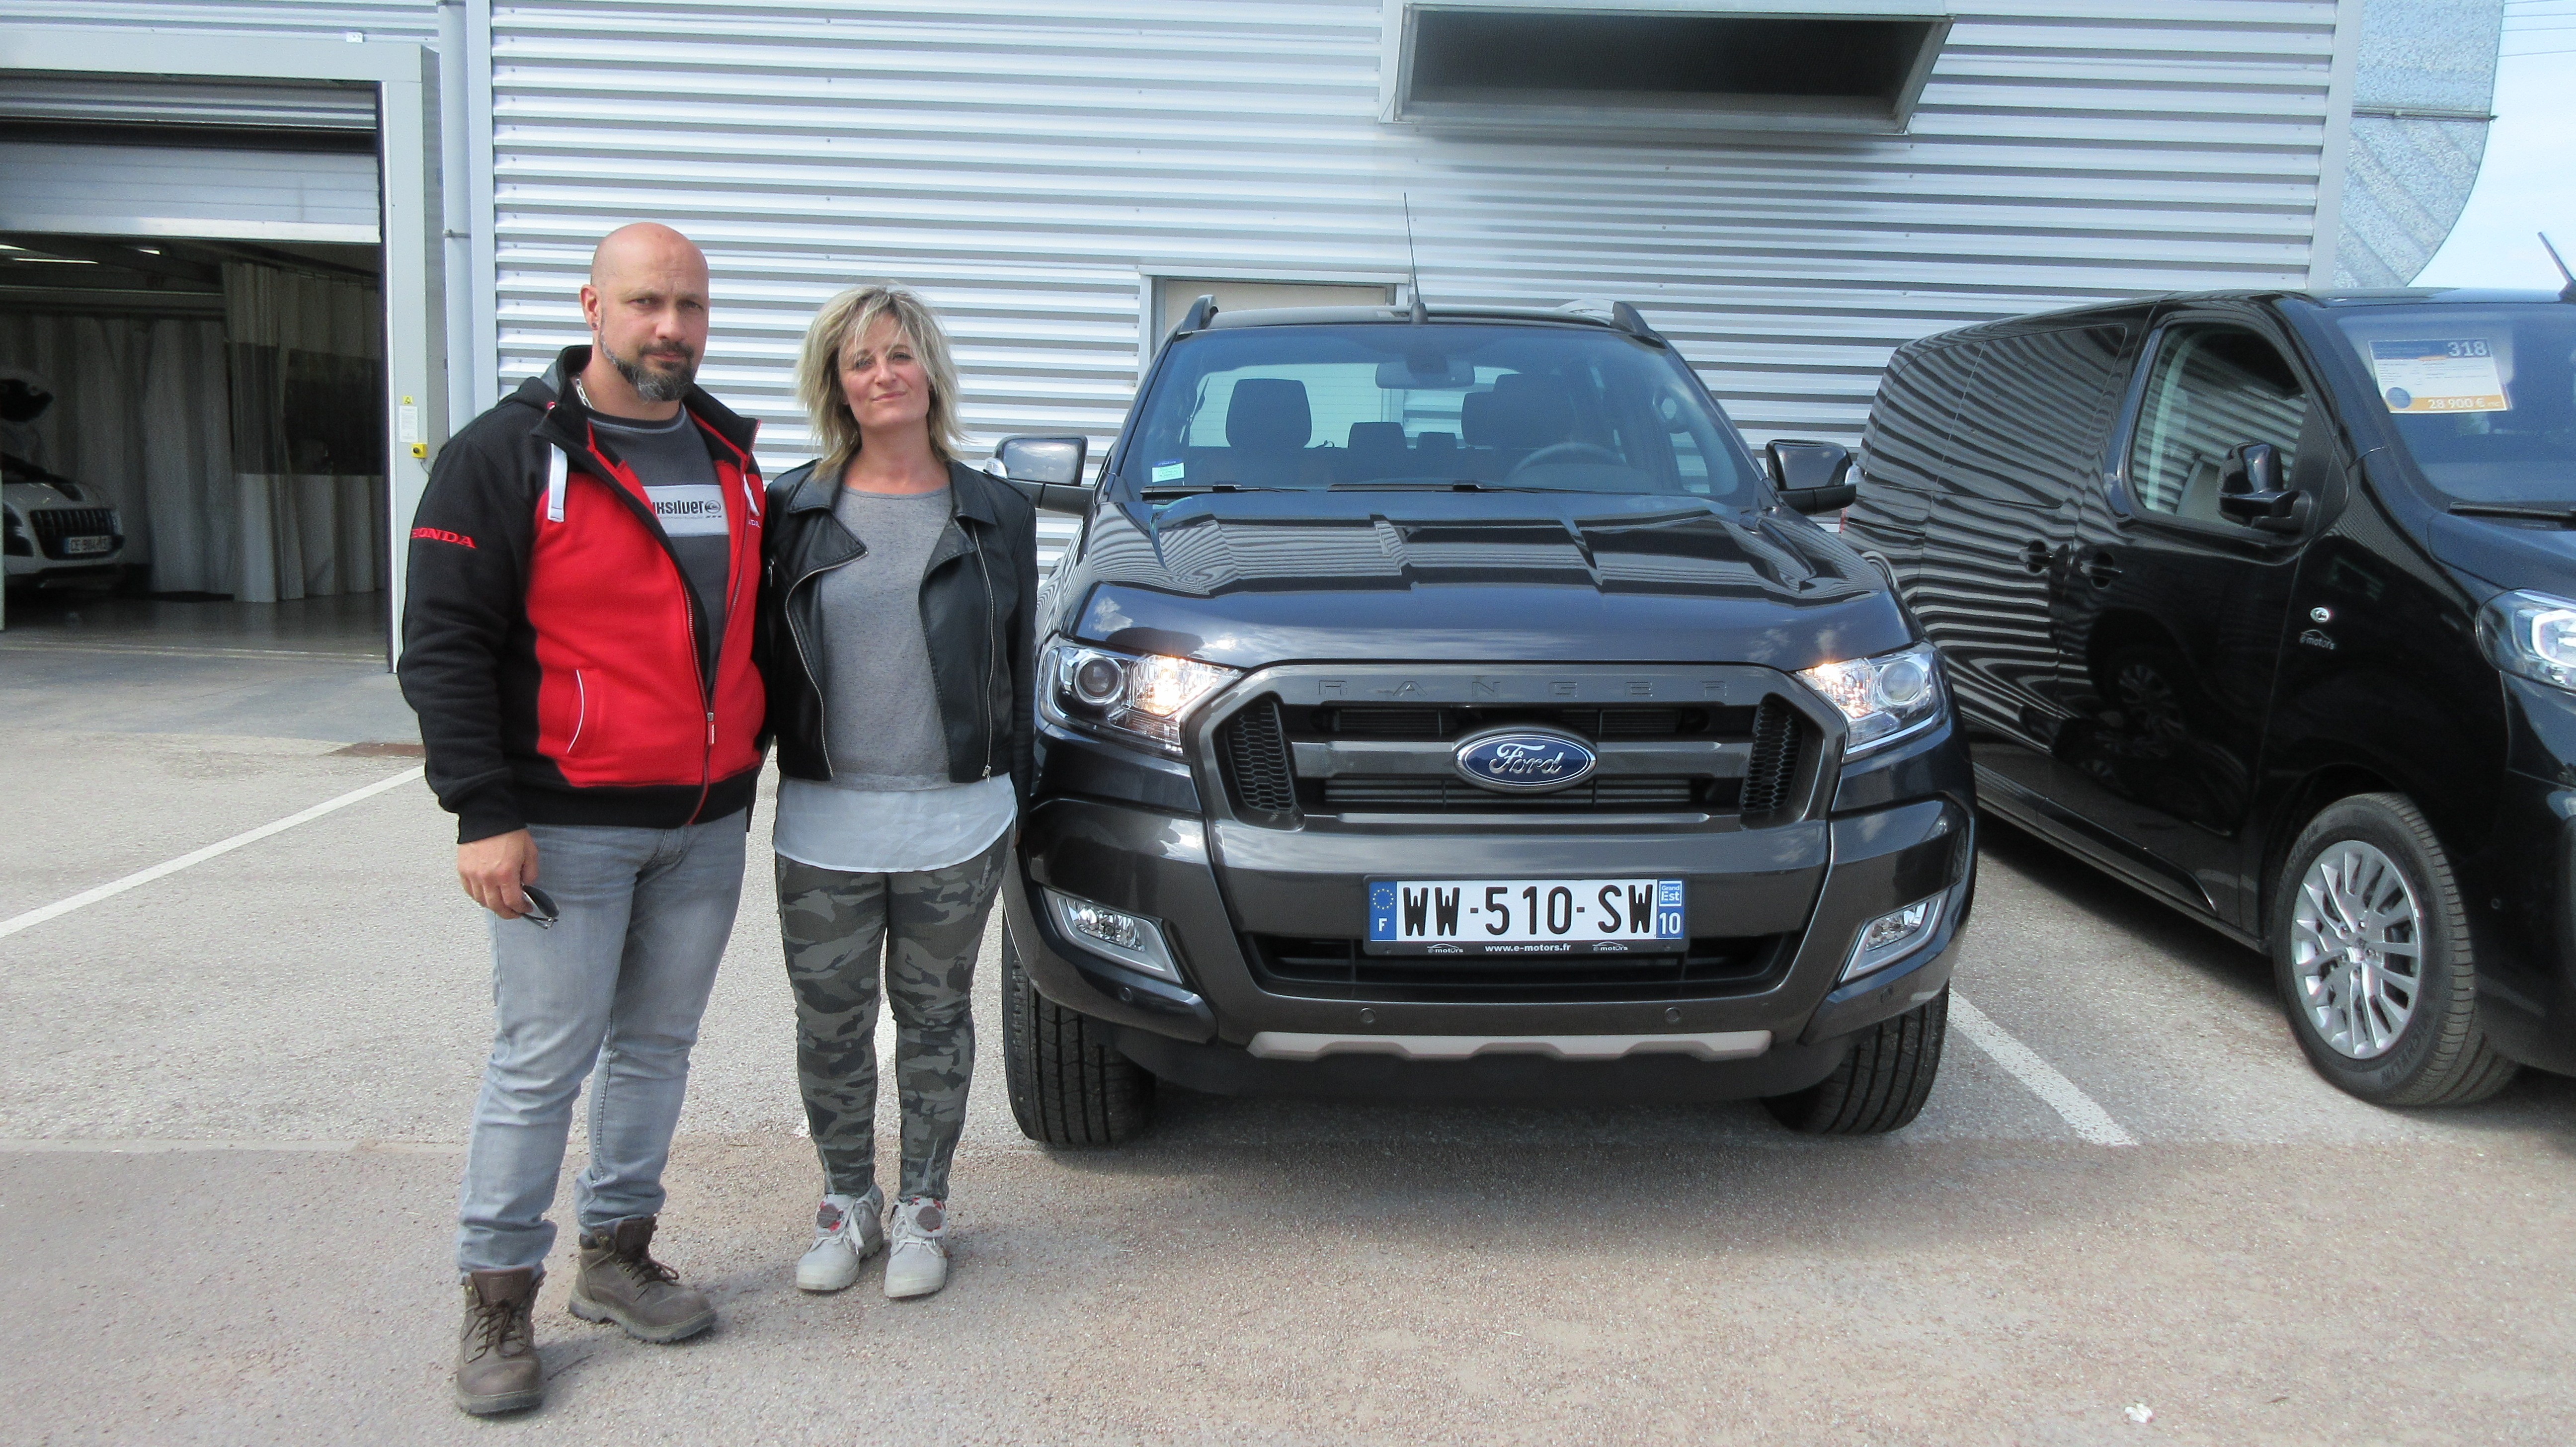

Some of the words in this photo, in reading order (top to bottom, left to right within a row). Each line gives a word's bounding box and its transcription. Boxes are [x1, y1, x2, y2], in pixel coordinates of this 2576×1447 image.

[2448, 341, 2487, 357] 318
[2428, 399, 2444, 409] 28
[2448, 399, 2473, 408] 900
[1318, 680, 1727, 697] RANGER
[1489, 743, 1565, 774] Ford
[1661, 891, 1680, 901] Est
[1403, 884, 1653, 936] WW-510-SW
[1378, 918, 1387, 931] F
[1659, 912, 1681, 934] 10
